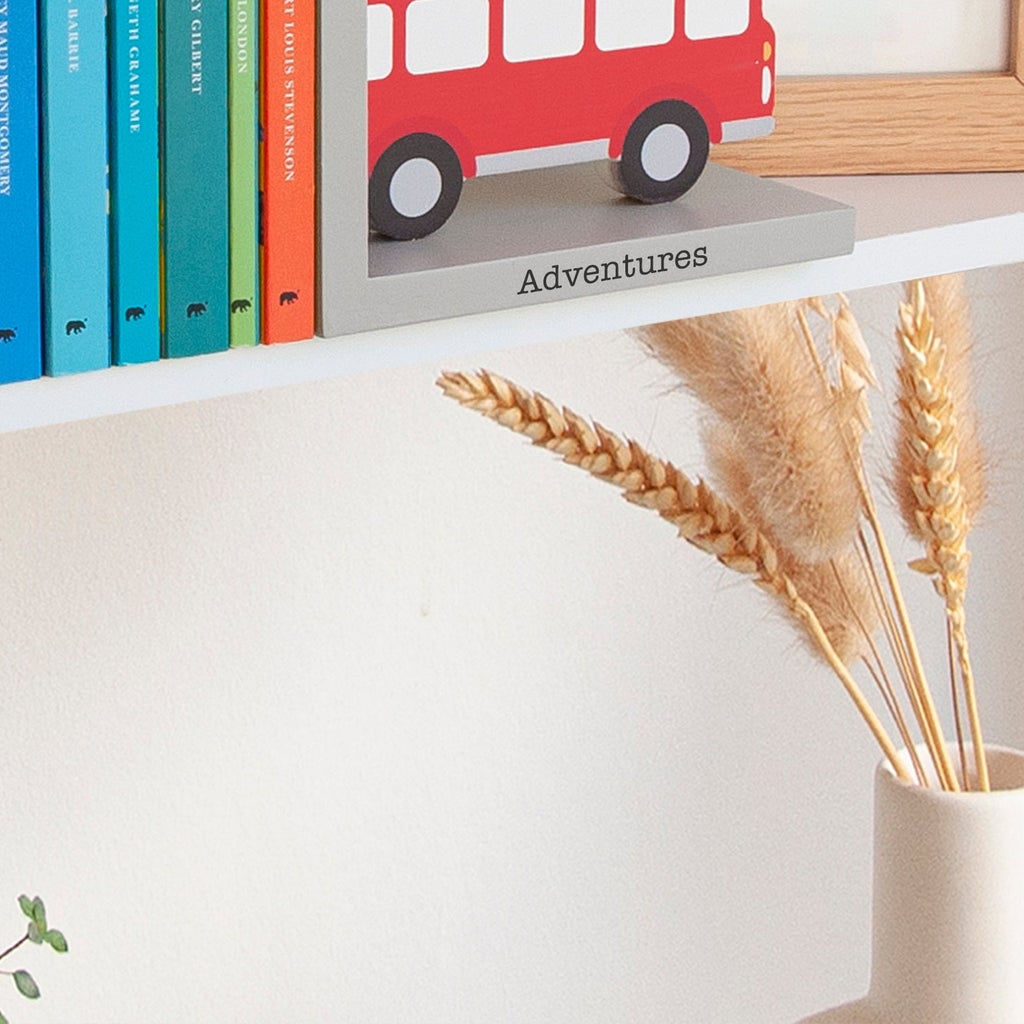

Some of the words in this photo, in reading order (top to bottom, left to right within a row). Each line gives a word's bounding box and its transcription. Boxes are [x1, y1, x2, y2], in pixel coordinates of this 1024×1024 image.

[67, 9, 80, 72] BARRIE
[191, 20, 202, 95] GILBERT
[237, 1, 248, 73] LONDON
[283, 22, 295, 74] LOUIS
[129, 47, 141, 133] GRAHAME
[283, 80, 295, 181] STEVENSON
[517, 246, 708, 295] Adventures
